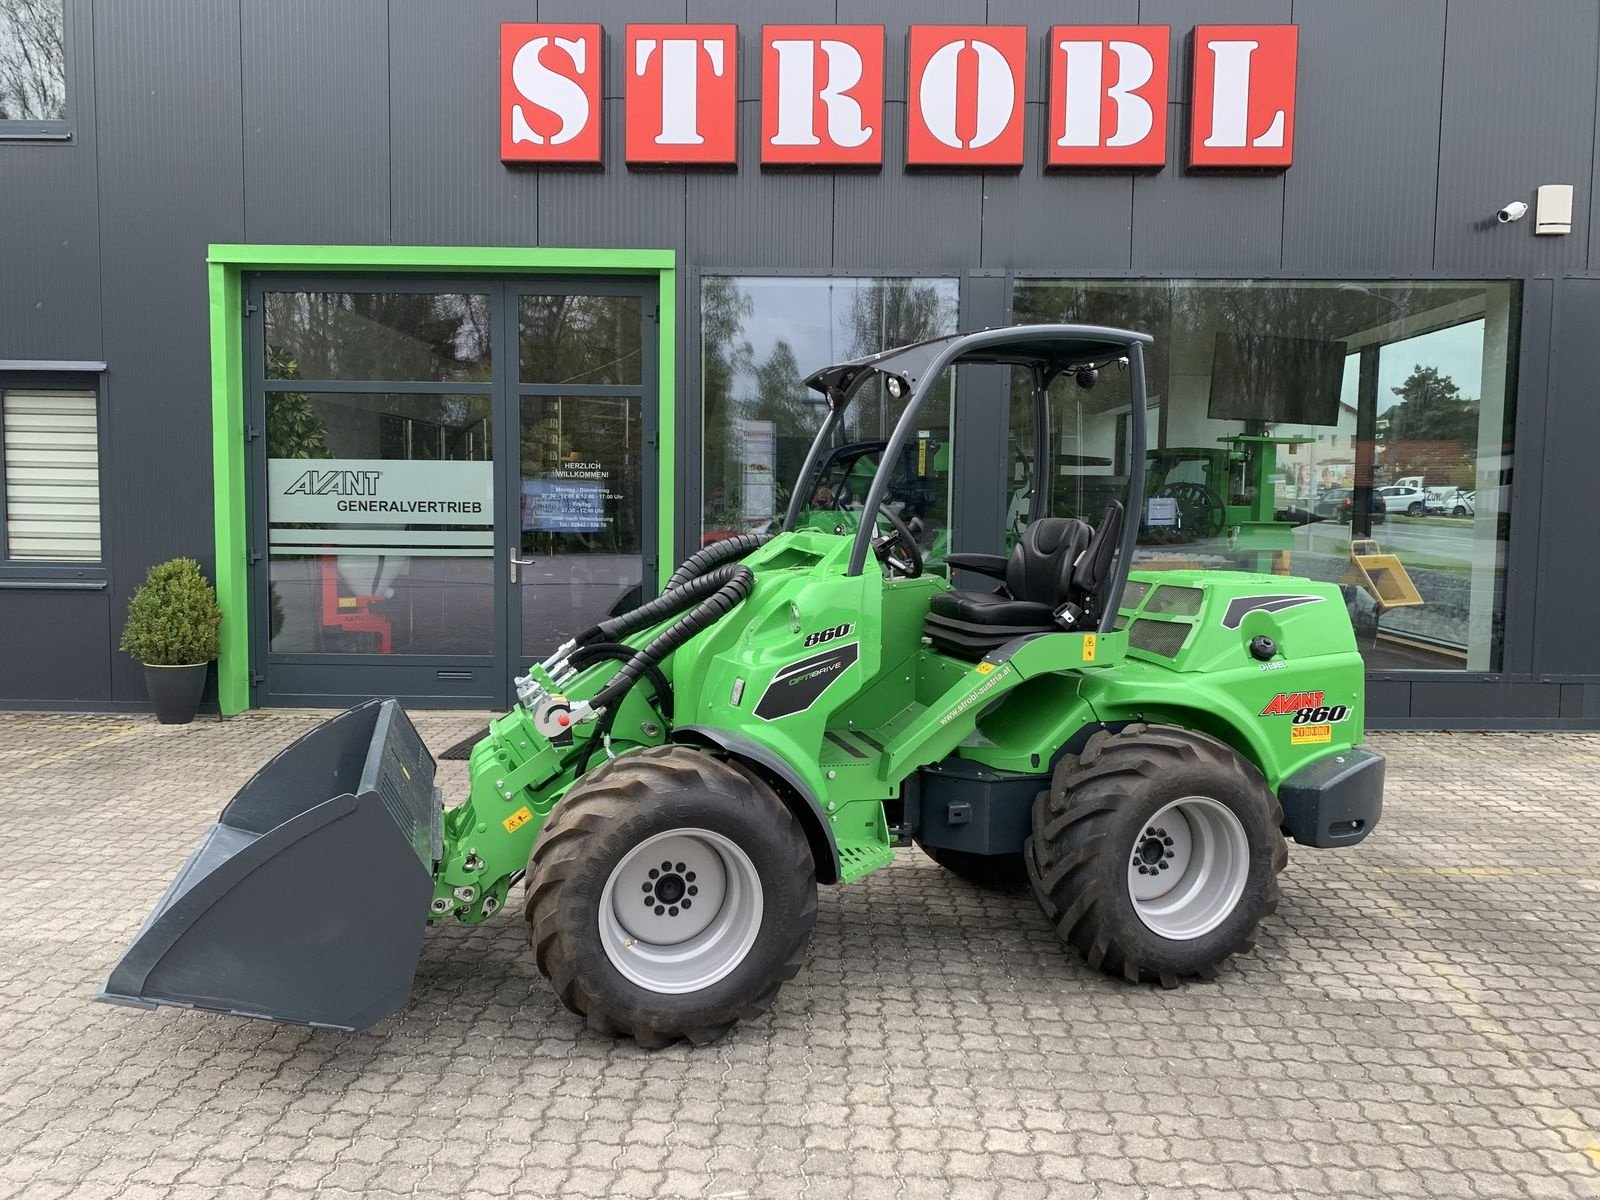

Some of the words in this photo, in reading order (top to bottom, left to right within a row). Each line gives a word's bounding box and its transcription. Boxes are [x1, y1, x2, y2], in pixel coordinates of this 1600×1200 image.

[511, 36, 1284, 150] STROBL
[564, 462, 601, 470] HERZLICH
[283, 470, 380, 496] AVANT
[337, 500, 482, 513] GENERALVERTRIEB
[788, 661, 842, 686] OPTIDRIVE
[939, 666, 1011, 726] www.strobl-austria.at
[1259, 690, 1325, 716] AVANT
